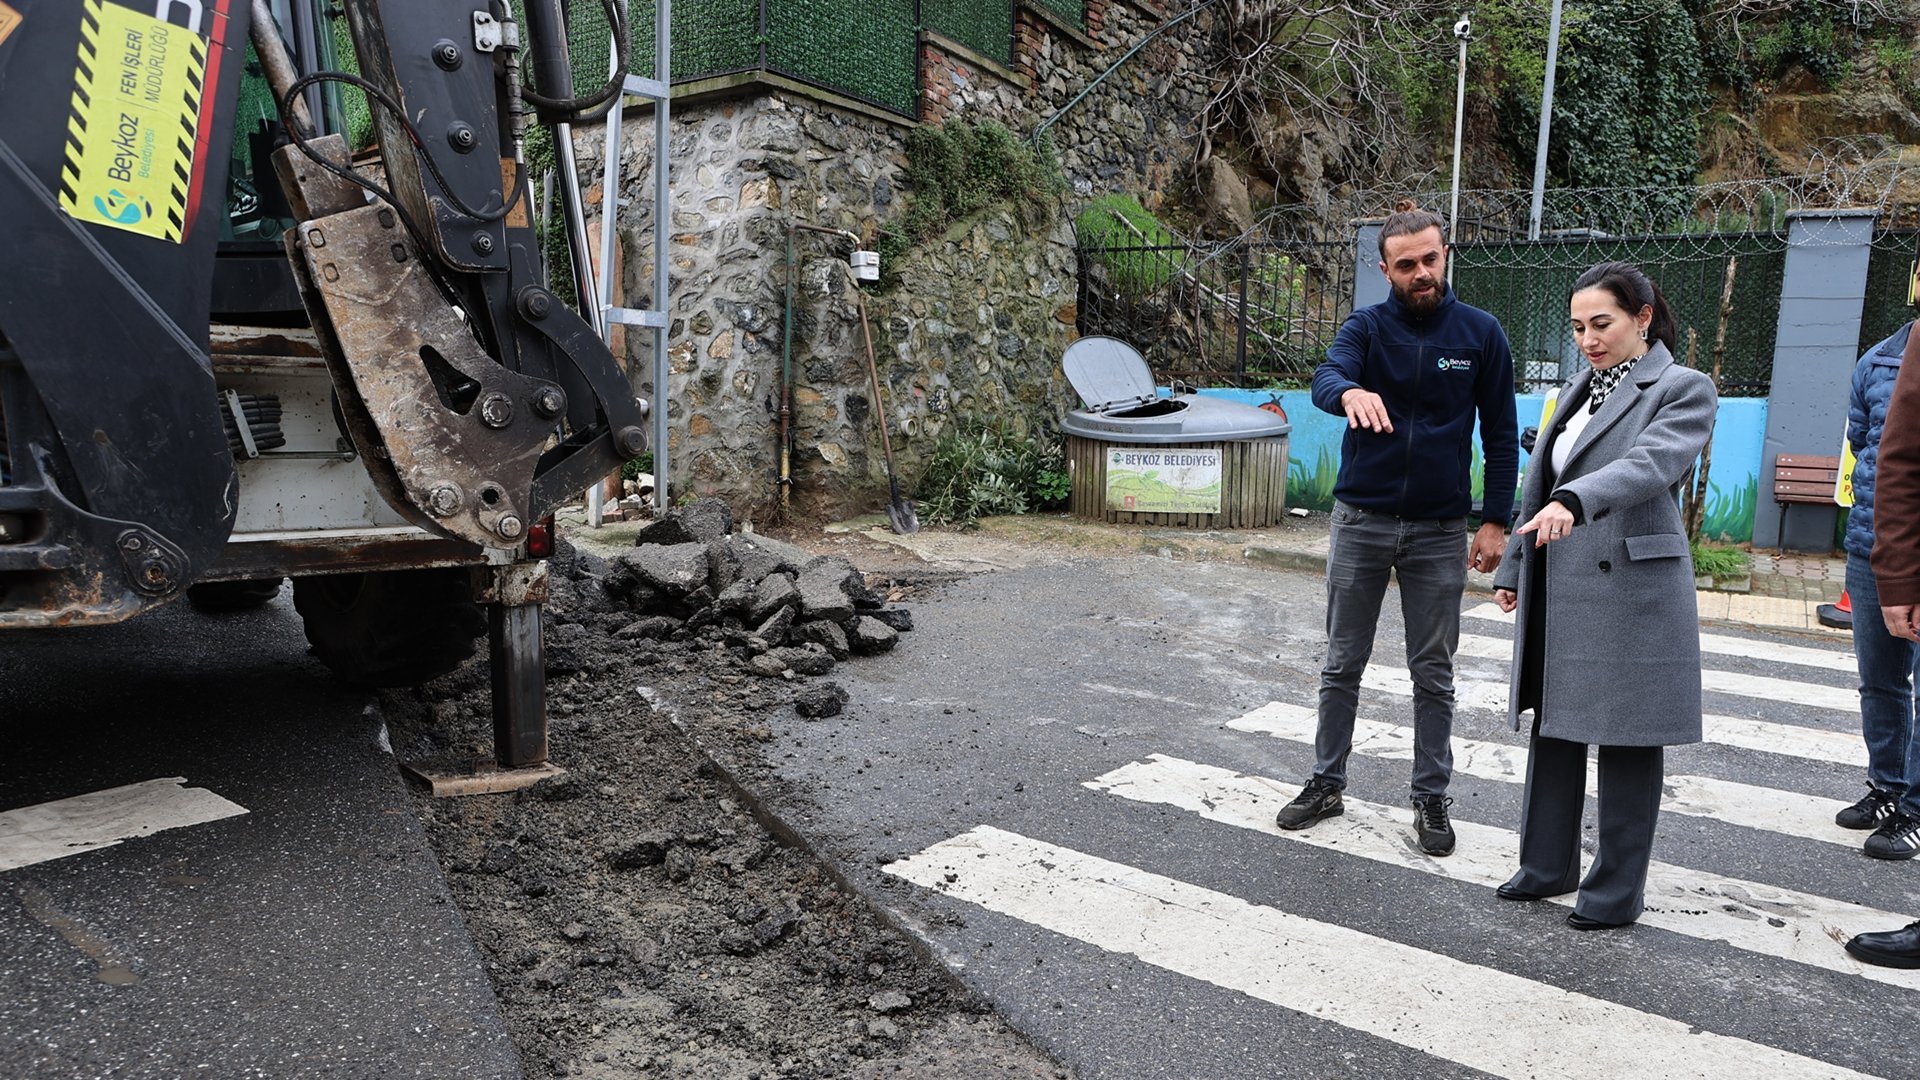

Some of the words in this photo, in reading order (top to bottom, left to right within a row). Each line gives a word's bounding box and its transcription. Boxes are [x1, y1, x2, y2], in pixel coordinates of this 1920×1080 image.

[121, 28, 144, 69] İŞLERİ
[144, 26, 169, 103] MÜDÜRLÜĞÜ
[120, 70, 138, 96] FEN
[107, 112, 139, 182] Beykoz
[138, 128, 155, 178] Belediyesi
[1126, 454, 1160, 465] BEYKOZ
